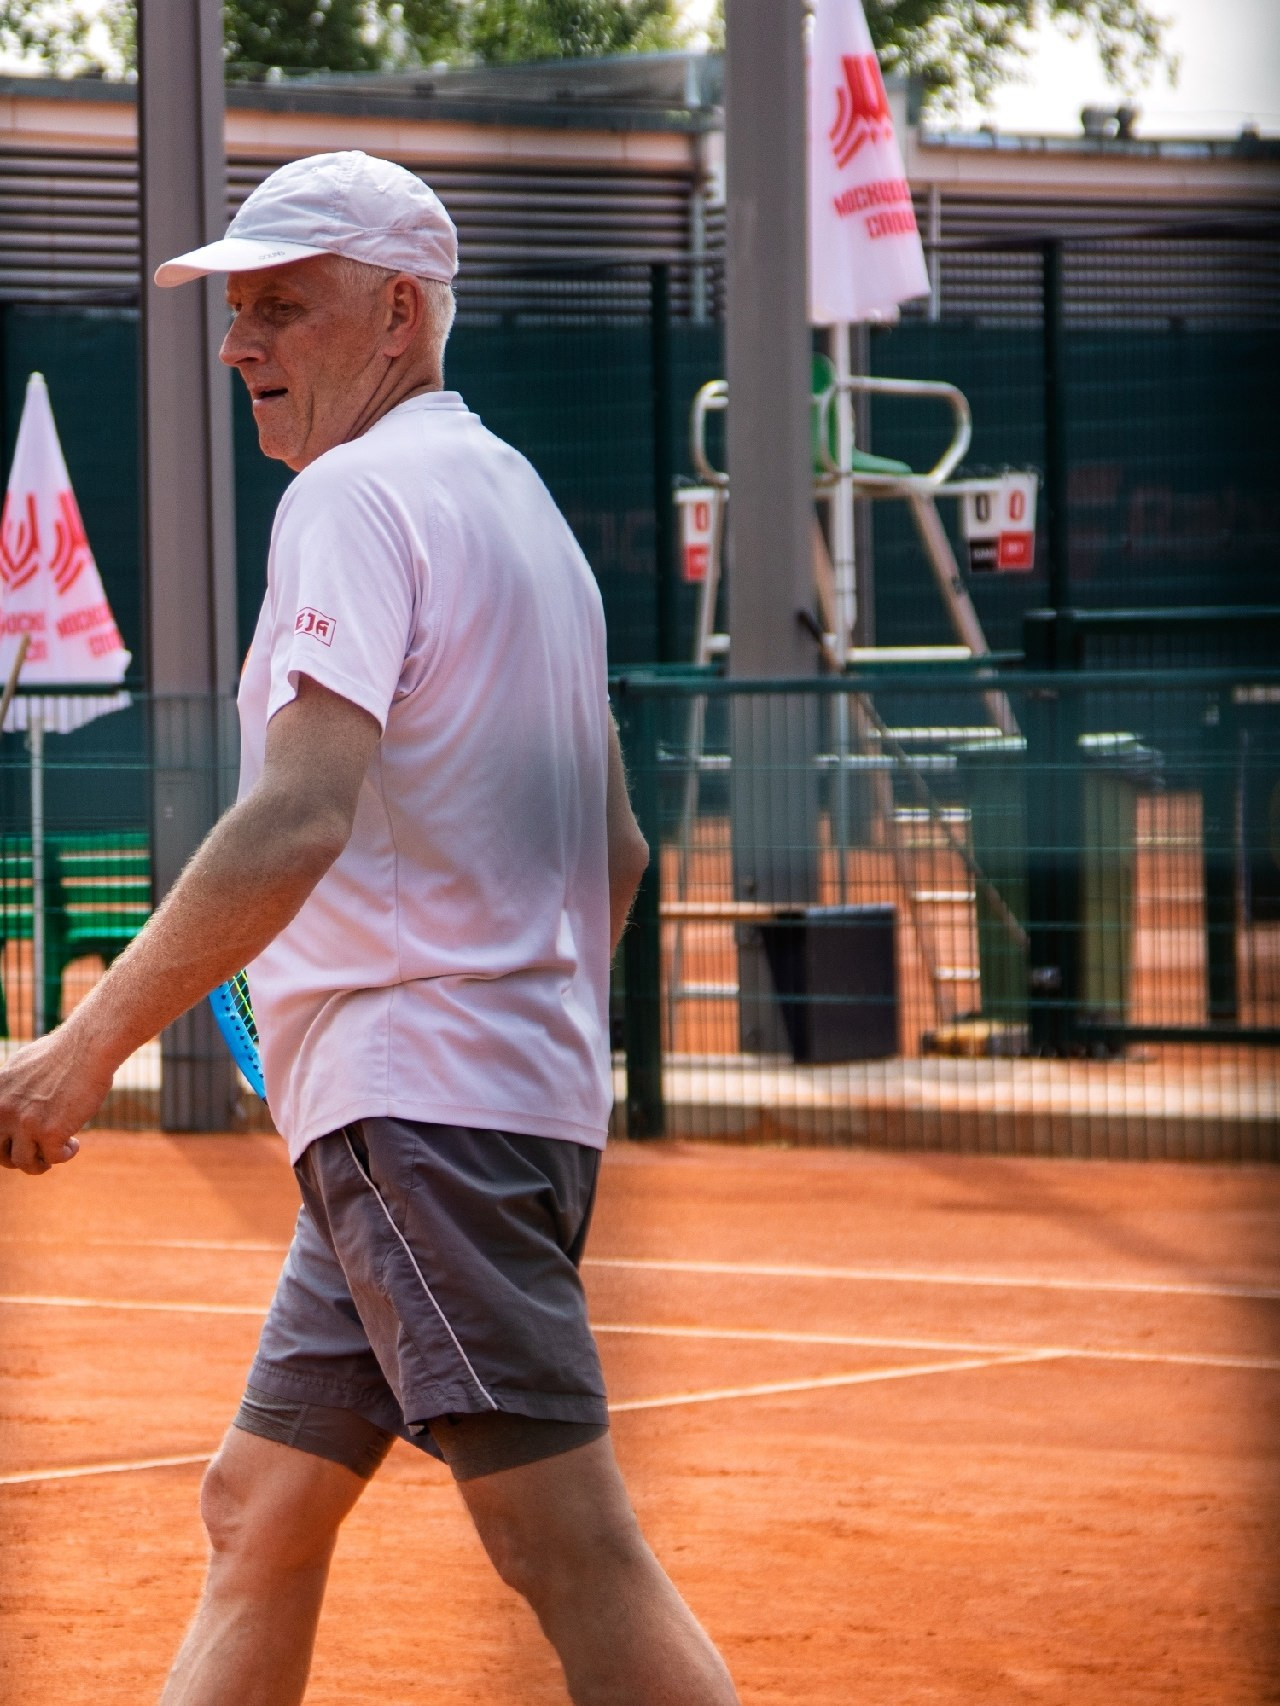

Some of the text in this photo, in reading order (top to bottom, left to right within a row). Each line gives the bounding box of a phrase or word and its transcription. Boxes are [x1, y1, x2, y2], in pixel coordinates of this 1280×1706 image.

[694, 501, 709, 533] 0
[974, 489, 1026, 523] 0 0
